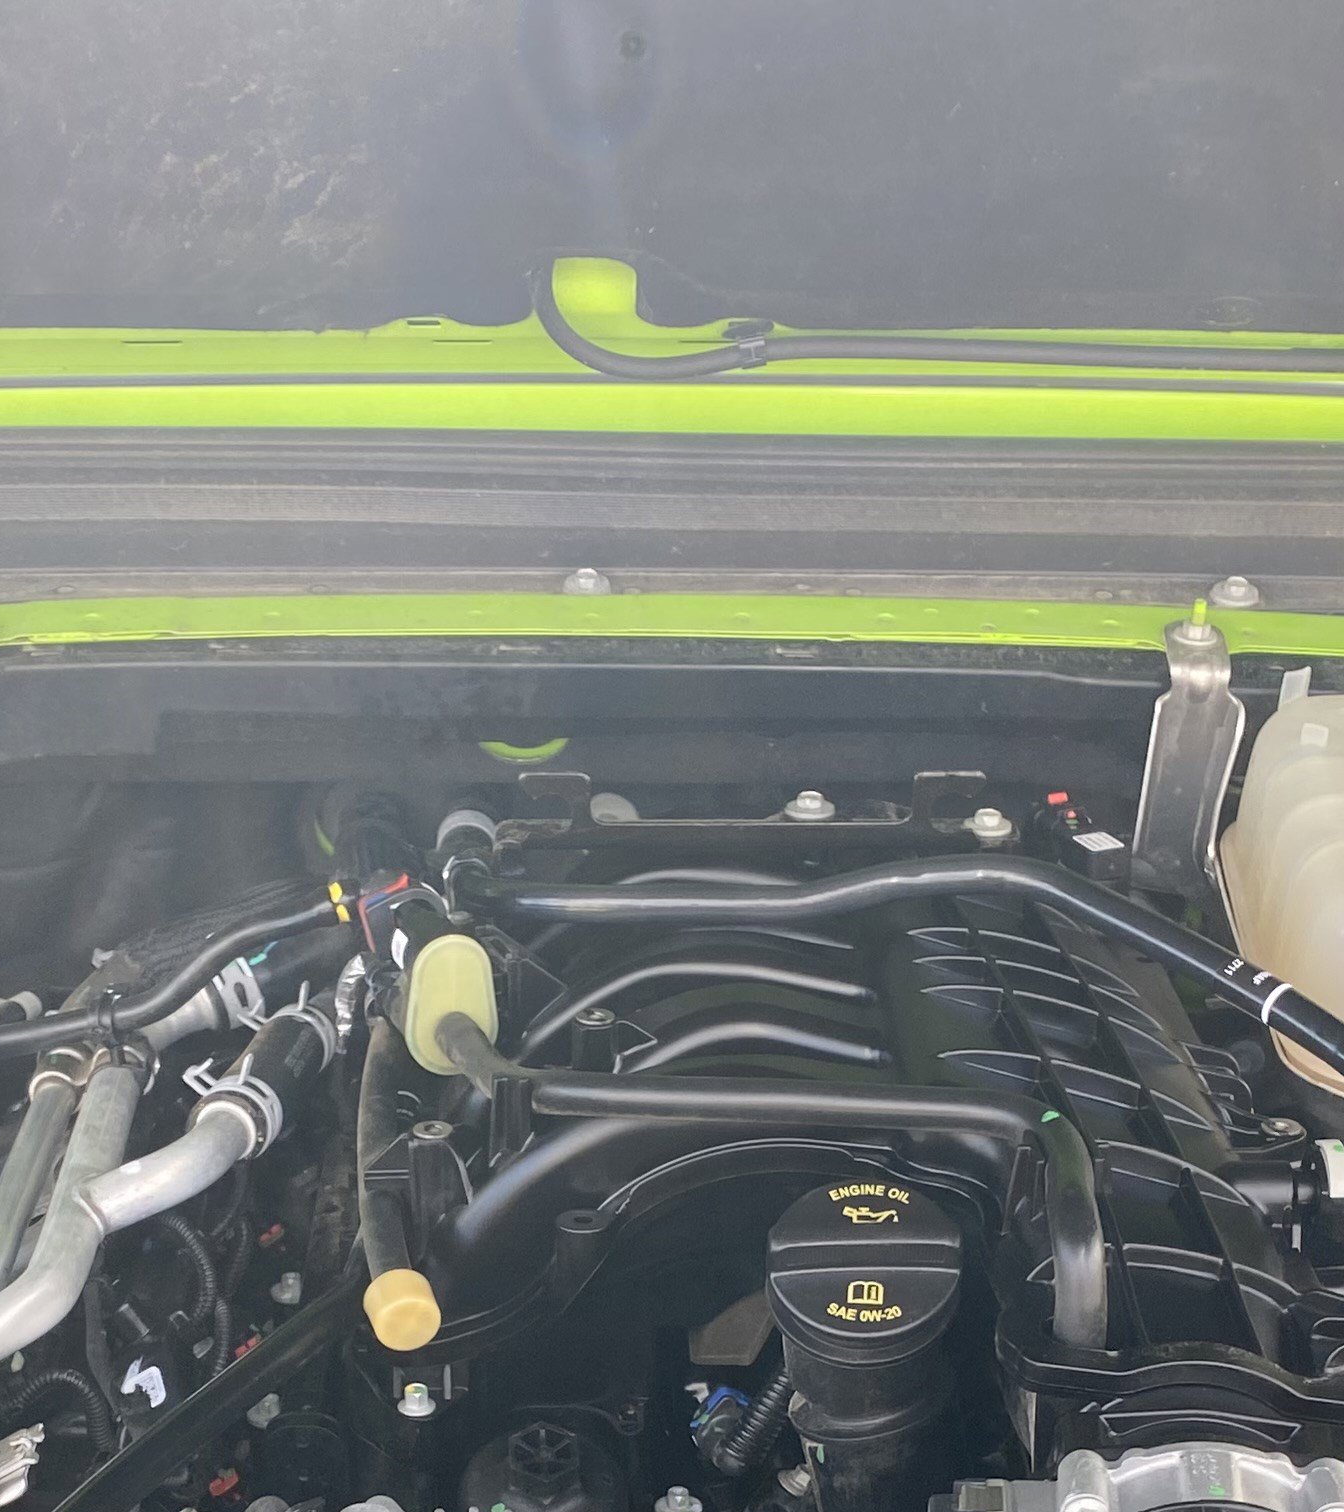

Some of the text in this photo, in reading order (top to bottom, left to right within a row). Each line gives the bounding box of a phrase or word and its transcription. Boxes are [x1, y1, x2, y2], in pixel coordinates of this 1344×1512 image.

[828, 1184, 910, 1205] ENGINE OIL
[826, 1302, 902, 1322] SAE 0W-20
